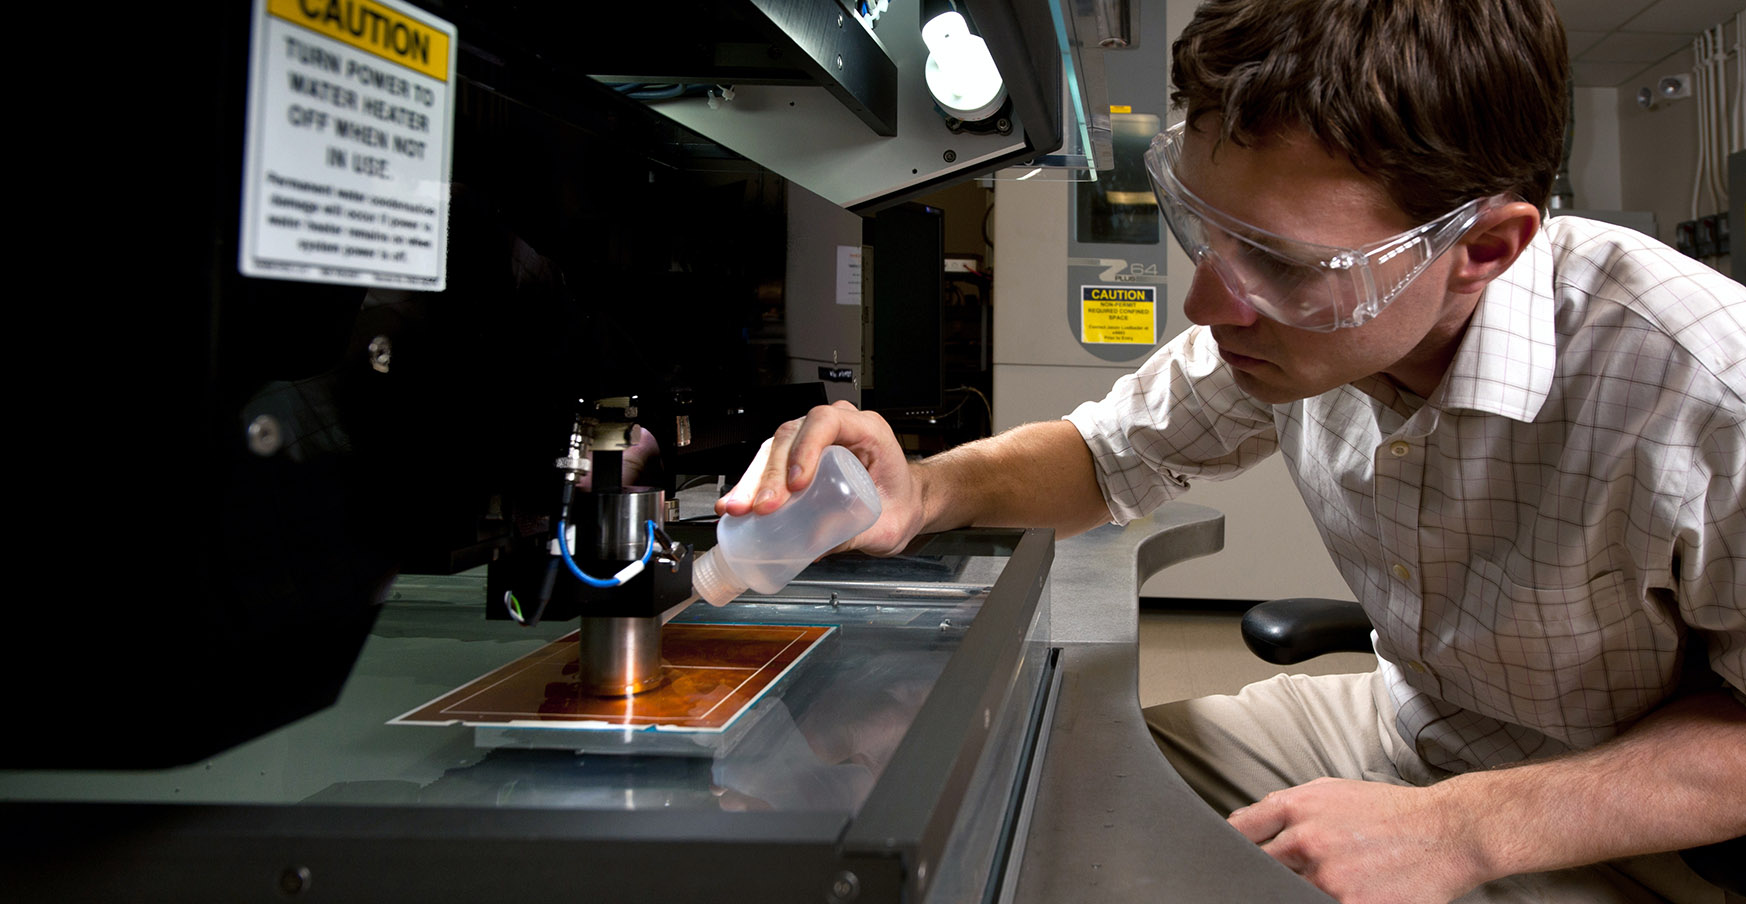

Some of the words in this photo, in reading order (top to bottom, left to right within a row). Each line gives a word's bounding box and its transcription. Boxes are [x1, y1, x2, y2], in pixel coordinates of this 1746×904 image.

[298, 0, 430, 65] CAUTION
[285, 35, 341, 74] TURN
[346, 60, 410, 98] POWER
[414, 85, 435, 107] TO
[287, 71, 359, 110] WATER
[362, 96, 430, 133] HEATER
[288, 105, 327, 131] OFF
[334, 116, 389, 150] WHEN
[392, 135, 427, 160] NOT
[326, 147, 346, 169] IN
[352, 153, 393, 180] USE.
[1091, 289, 1146, 300] CAUTION
